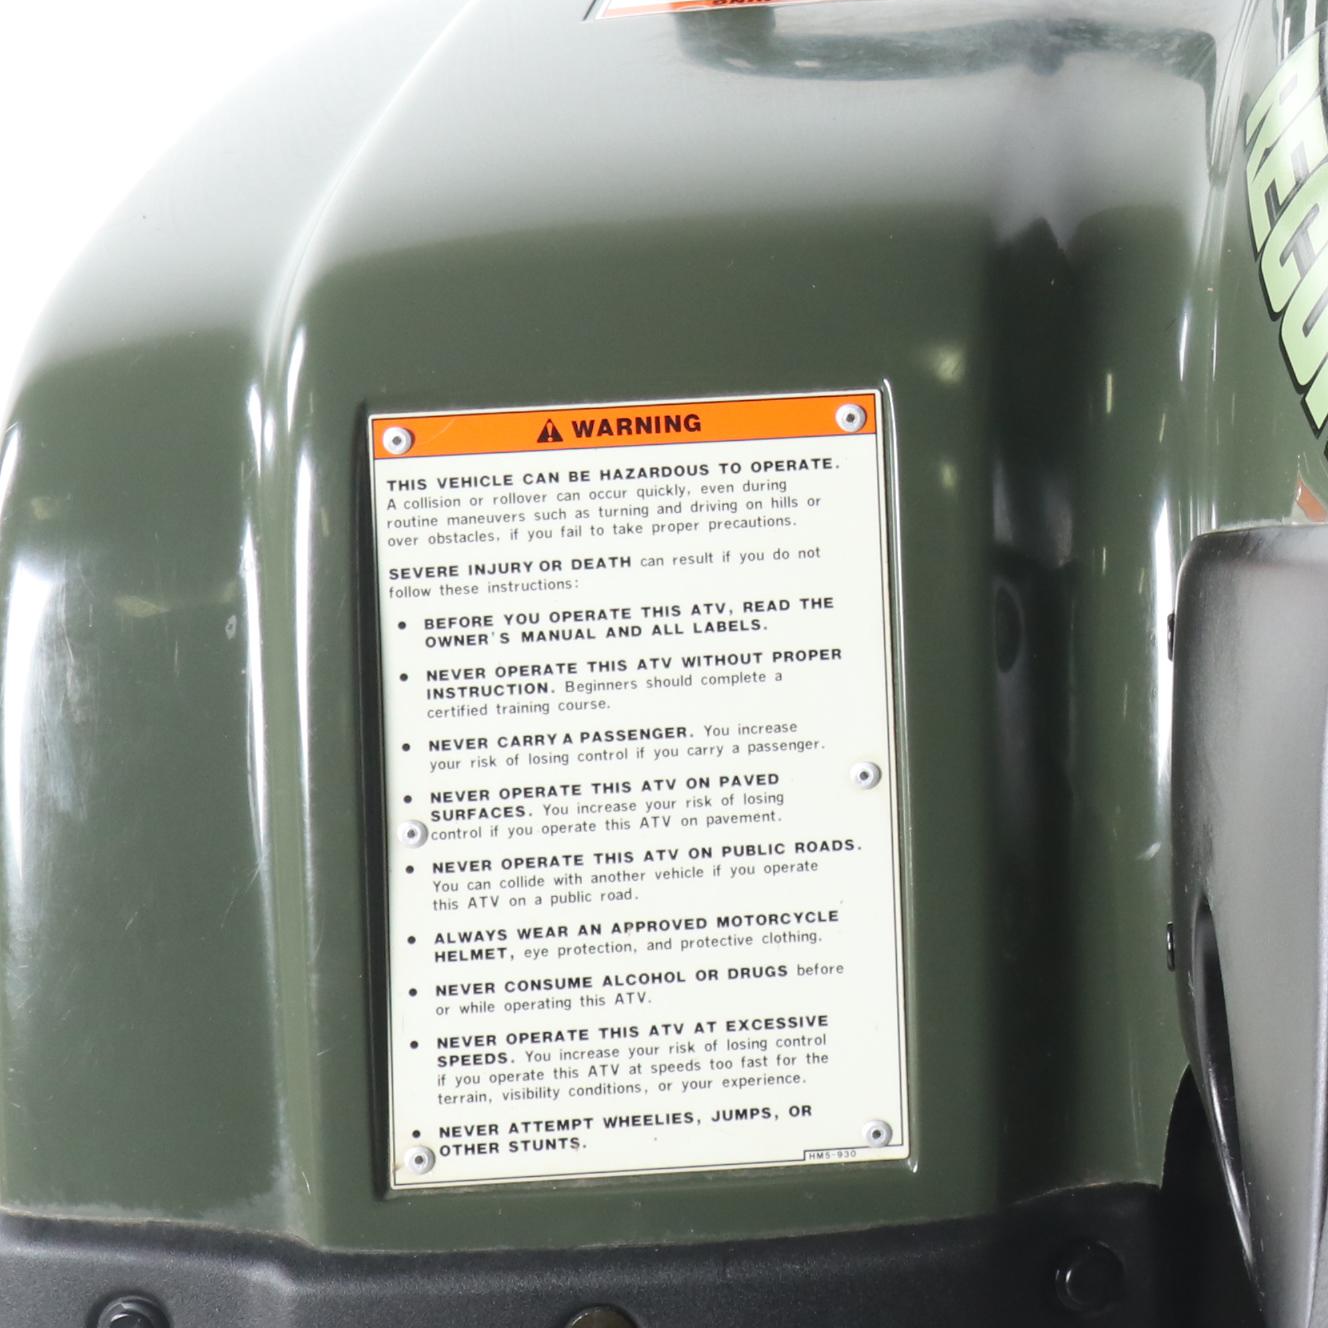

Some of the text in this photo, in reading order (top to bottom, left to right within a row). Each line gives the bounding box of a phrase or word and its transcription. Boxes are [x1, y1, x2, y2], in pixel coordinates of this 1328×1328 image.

[571, 414, 702, 439] WARNING
[386, 457, 839, 491] THIS VEHICLE CAN BE HAZARDOUS TO OPERATE.
[386, 479, 786, 510] A collision or rollover can occur quickly, even during
[388, 546, 820, 580] SEVERE INJURY OR DEATH can result if you do not
[389, 579, 577, 598] follow these instructions:
[423, 596, 834, 630] BEFORE YOU OPERATE THIS ATV, READ THE
[424, 618, 767, 648] OWNER'S MANUAL AND ALL LABELS.
[426, 648, 841, 682] NEVER OPERATE THIS ATV WITHOUT PROPER
[426, 671, 782, 700] INSTRUCTION. Beginners should complete a
[428, 723, 797, 752] NEVER CARRY A PASSENGER. You increase
[430, 772, 779, 804] NEVER OPERATE THIS ATV ON PAVED
[432, 838, 861, 874] NEVER OPERATE THIS ATV ON PUBLIC ROADS.
[434, 909, 838, 944] ALWAYS WEAR AN APPROVED MOTORCYCLE
[434, 930, 821, 963] HELMET, eye protection, and protective clothing.
[435, 962, 844, 997] NEVER CONSUME ALCOHOL OR DRUGS before
[436, 1014, 828, 1049] NEVER OPERATE THIS ATV AT EXCESSIVE
[438, 1104, 812, 1138] NEVER ATTEMPT WHEELIES, JUMPS, OR
[439, 1136, 586, 1157] OTHER STUNTS.
[808, 1150, 857, 1160] HM5-930
